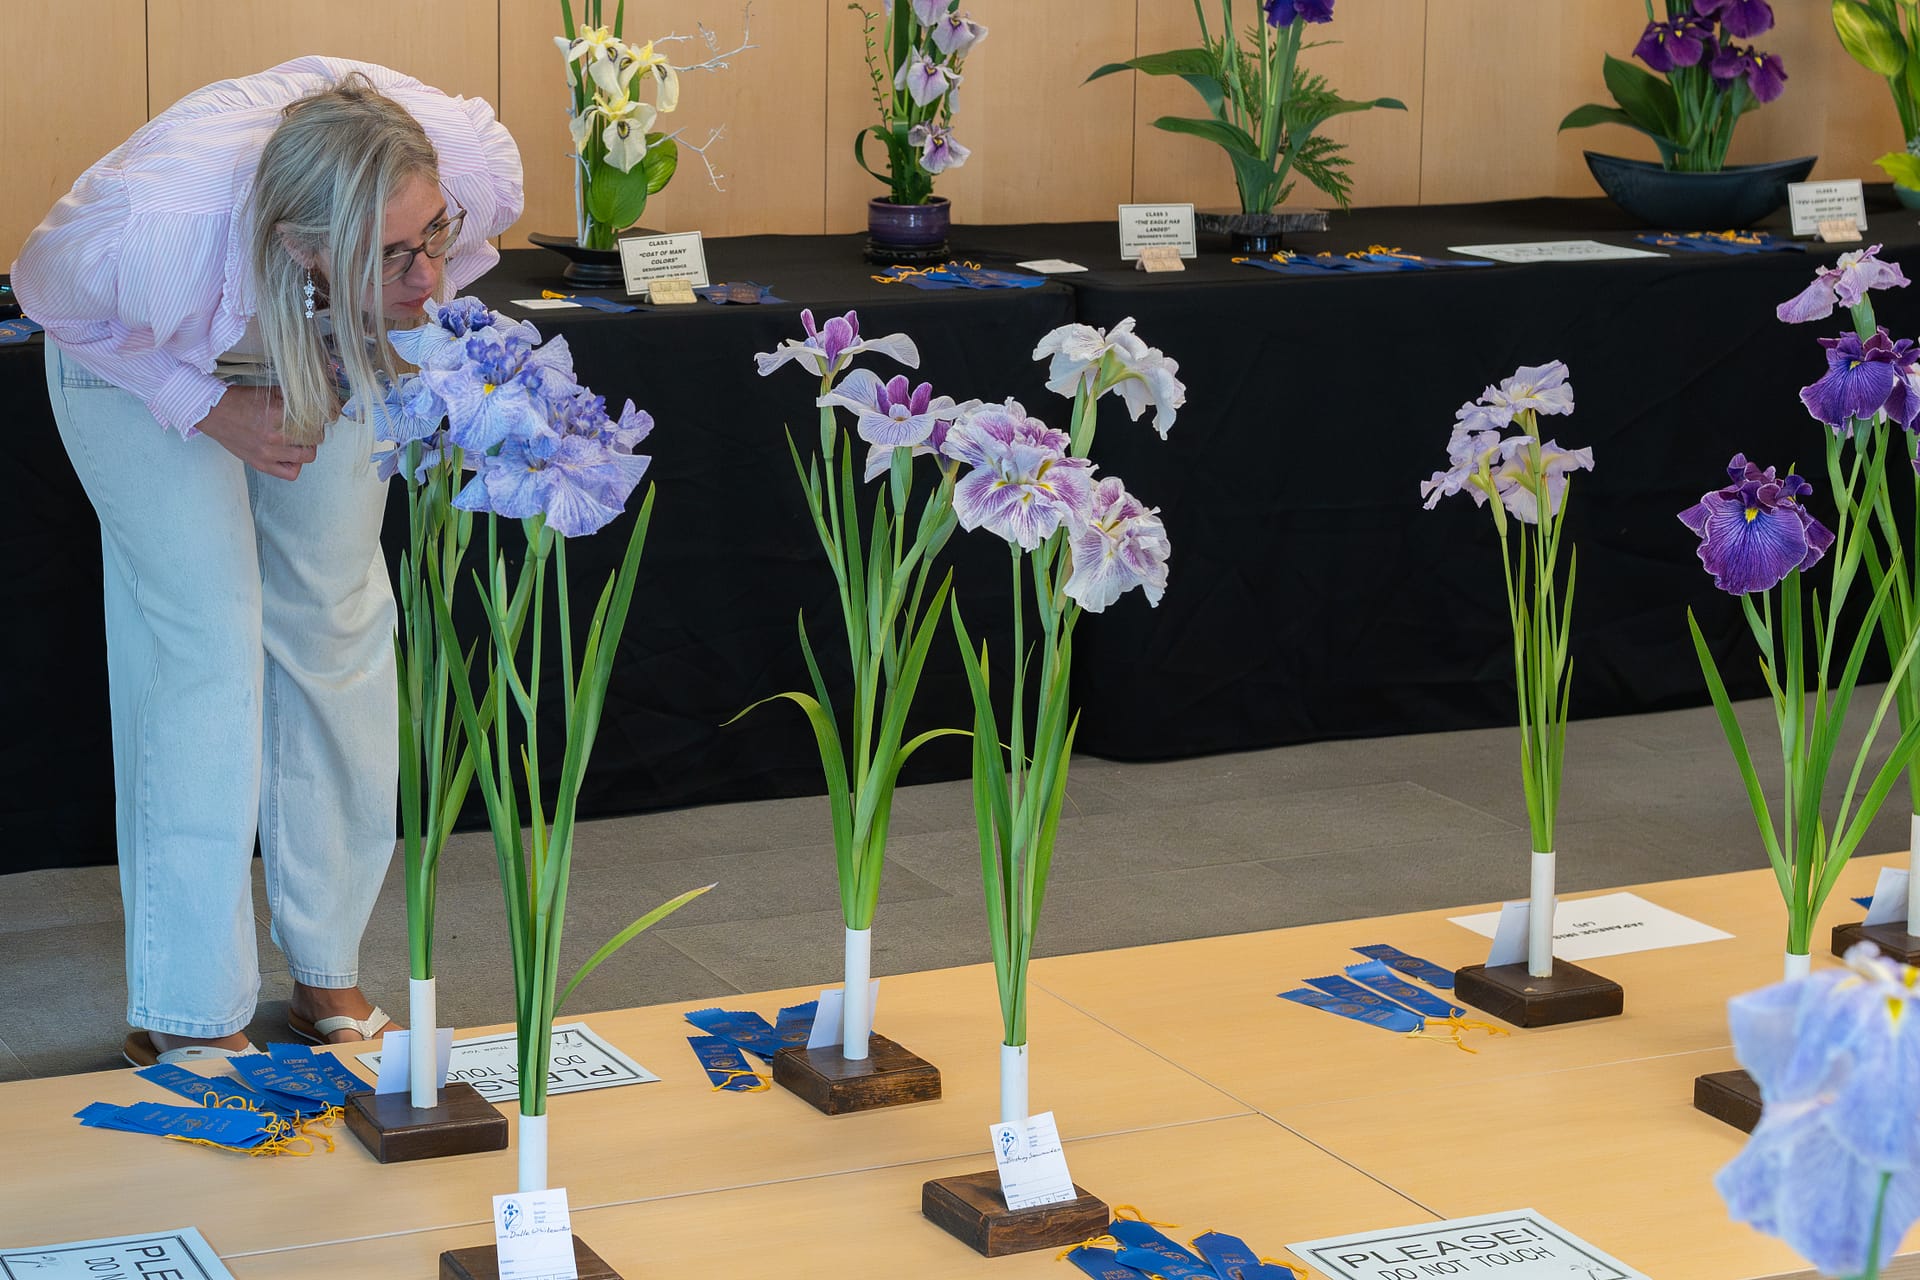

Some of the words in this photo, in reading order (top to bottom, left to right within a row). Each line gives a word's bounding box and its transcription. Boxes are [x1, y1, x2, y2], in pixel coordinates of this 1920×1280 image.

[651, 257, 678, 265] COLORS"
[554, 1054, 587, 1066] DO
[447, 1066, 503, 1081] TOUC
[1338, 1227, 1543, 1269] PLEASE!
[84, 1256, 121, 1272] DO
[1378, 1267, 1418, 1280] DO
[1419, 1259, 1470, 1277] NOT
[1470, 1246, 1556, 1268] TOUCH
